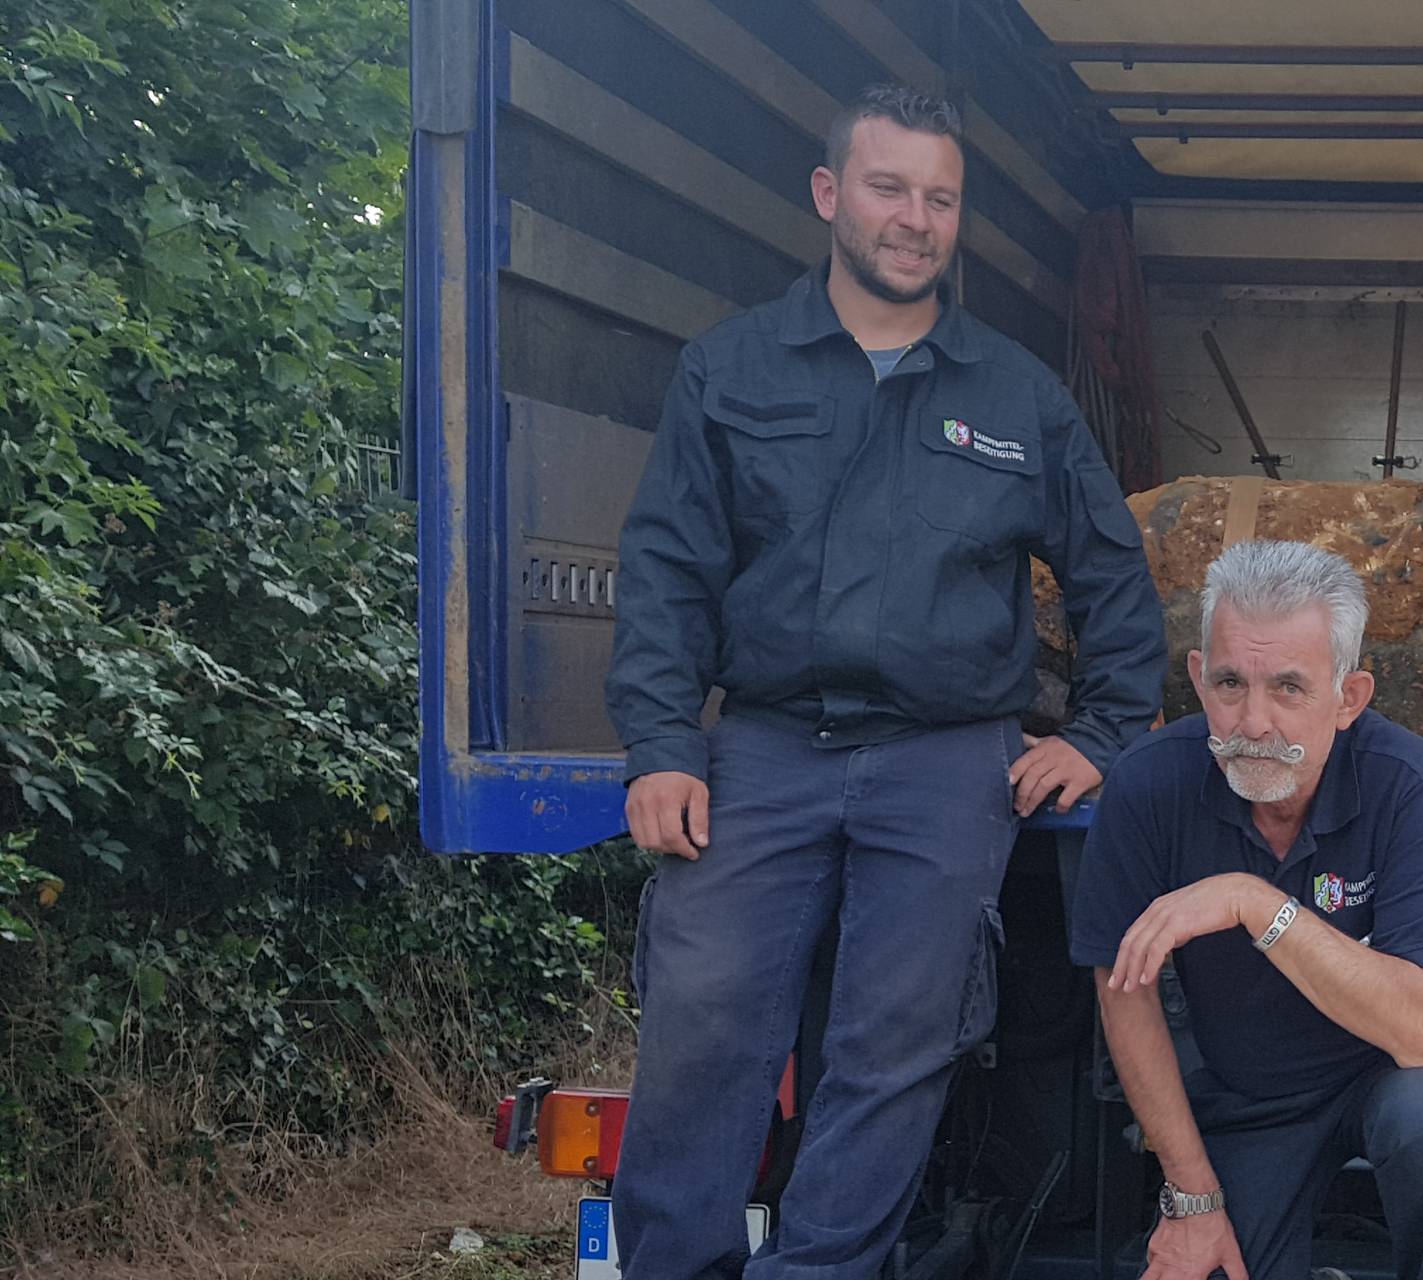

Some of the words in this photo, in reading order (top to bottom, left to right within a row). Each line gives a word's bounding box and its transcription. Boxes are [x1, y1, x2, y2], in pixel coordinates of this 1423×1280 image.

[973, 430, 1025, 451] KAMPFMITTEL-
[973, 441, 1025, 461] BESEITIGUNG
[588, 1238, 600, 1252] D
